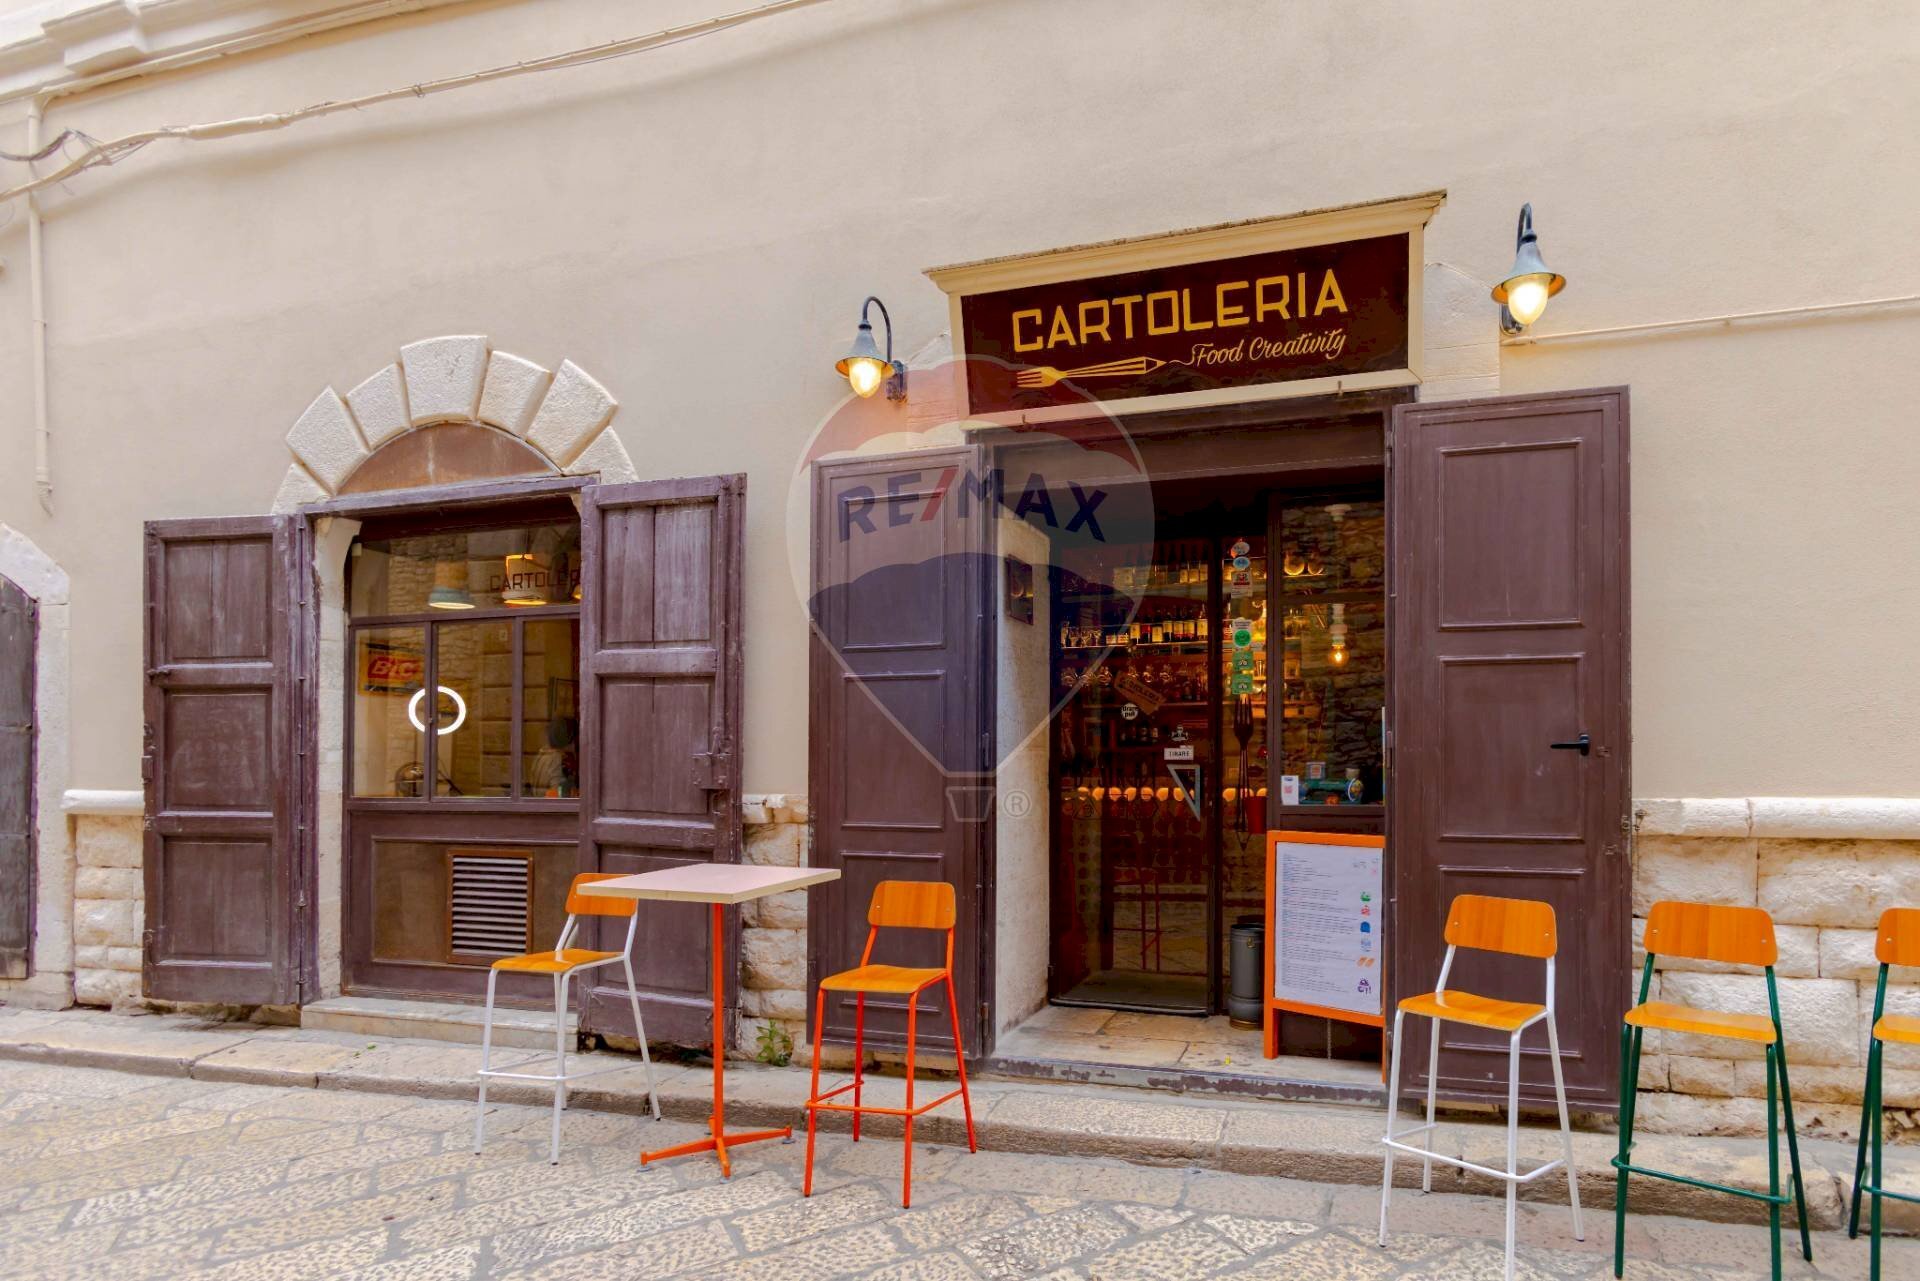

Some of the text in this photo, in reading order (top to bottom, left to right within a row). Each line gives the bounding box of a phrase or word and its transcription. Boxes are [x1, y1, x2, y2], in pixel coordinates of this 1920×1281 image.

[1011, 268, 1349, 354] CARTOLERIA
[1190, 328, 1347, 367] Food Creativity
